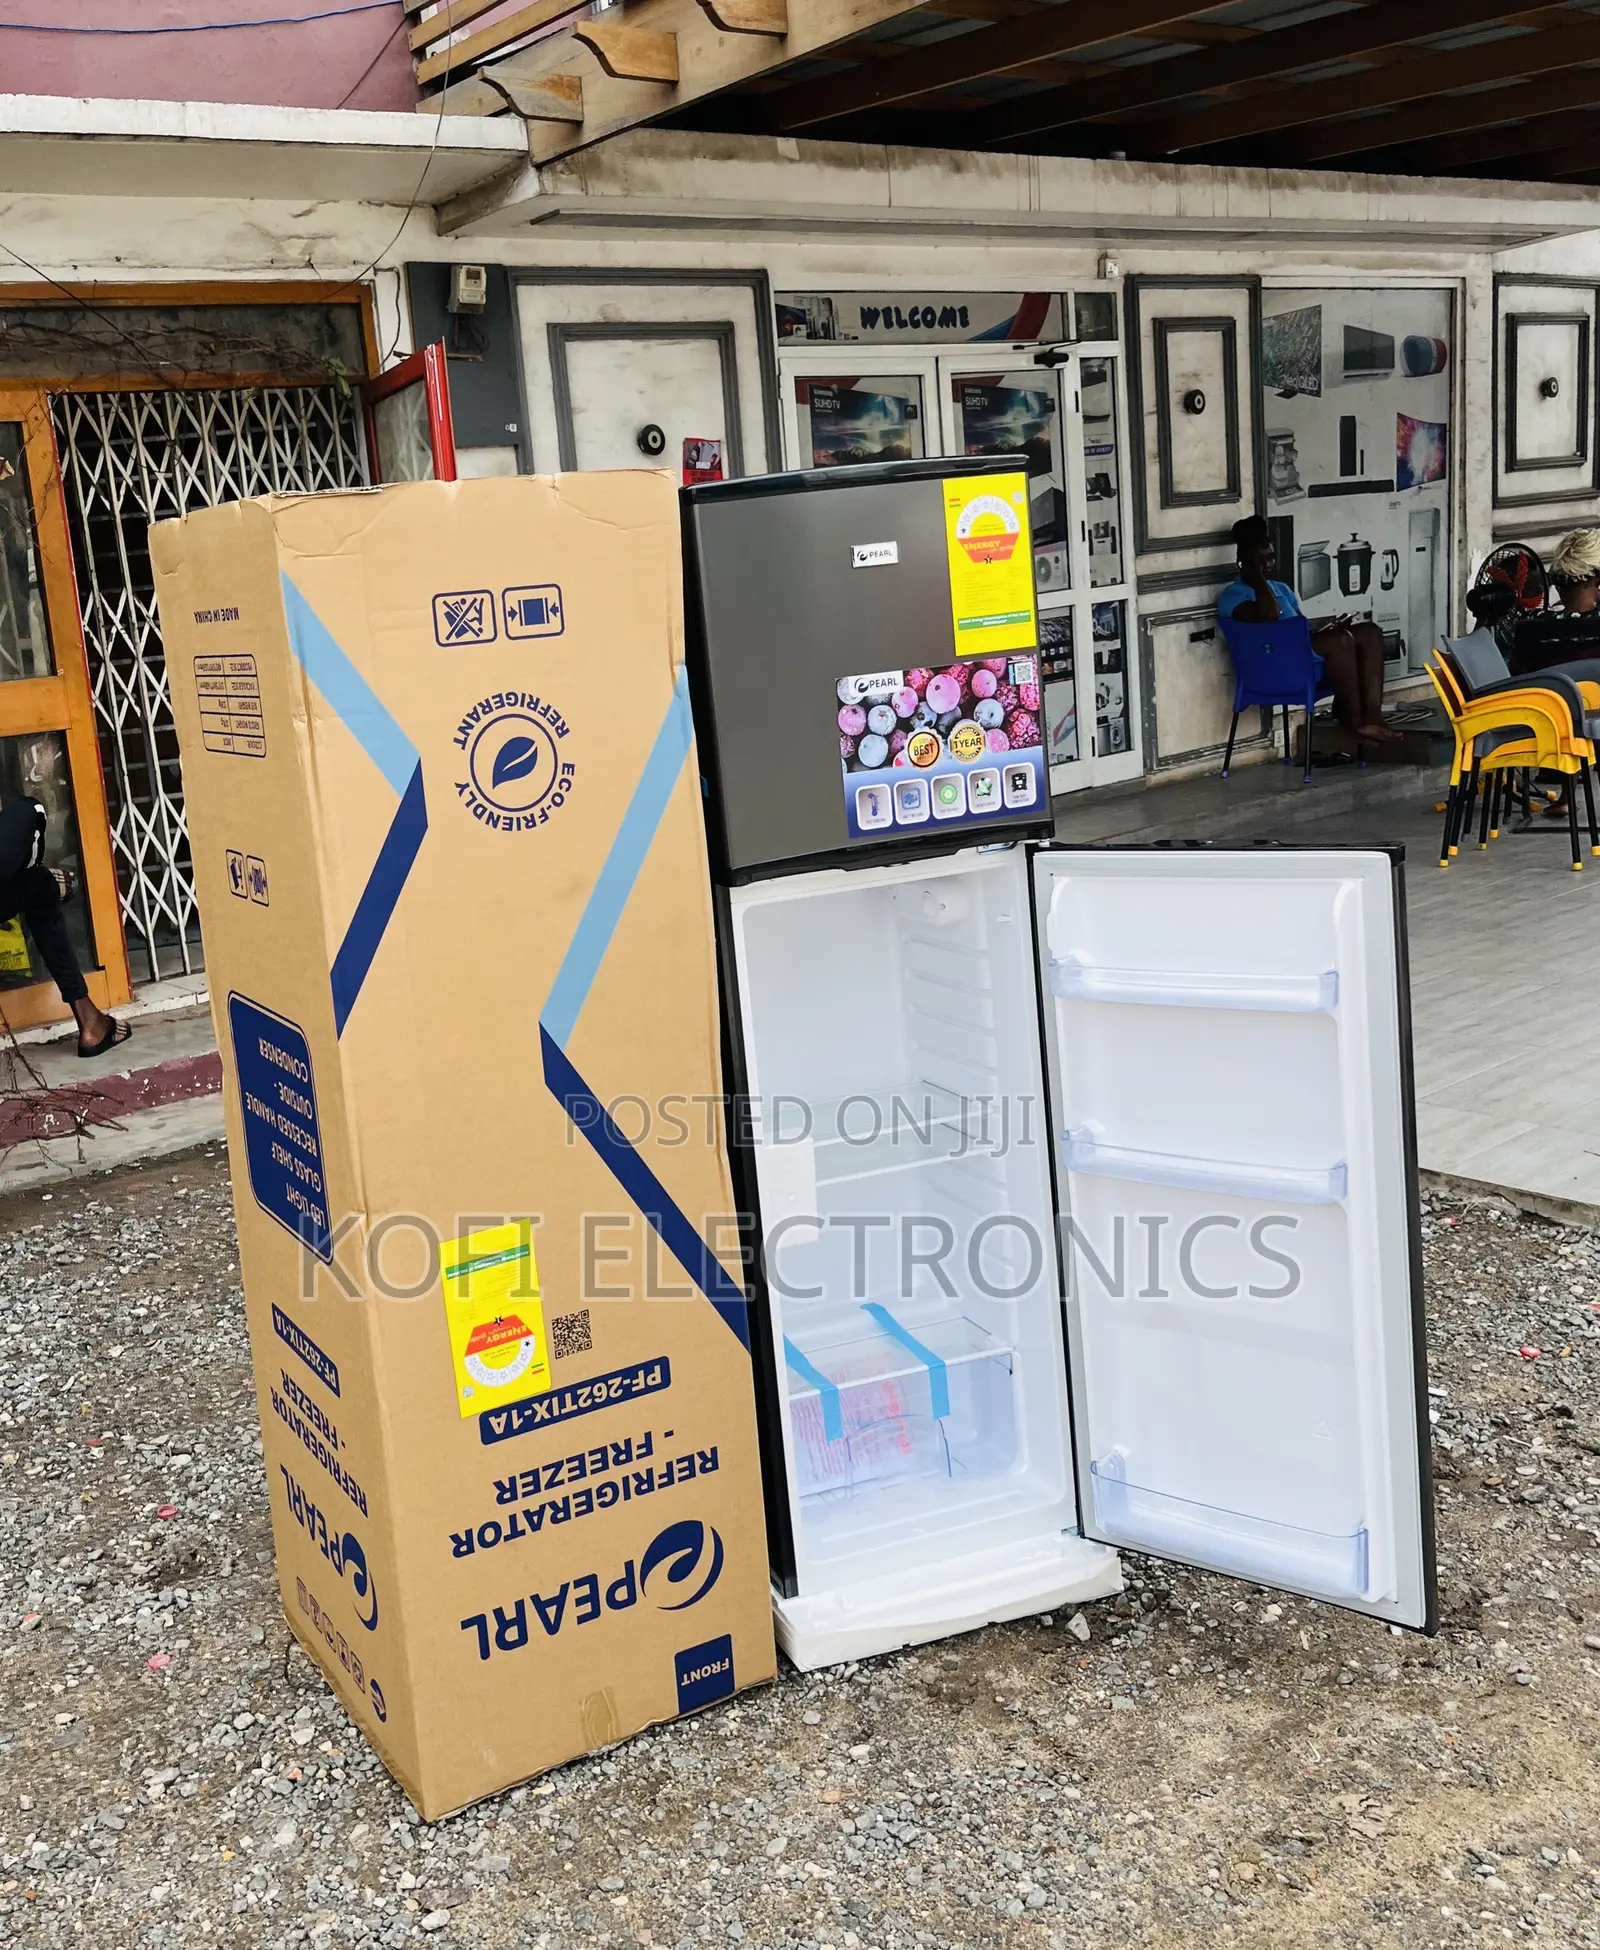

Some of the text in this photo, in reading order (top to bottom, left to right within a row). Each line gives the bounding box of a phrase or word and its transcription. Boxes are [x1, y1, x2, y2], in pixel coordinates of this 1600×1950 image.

[860, 305, 970, 330] WELCOME
[869, 549, 893, 558] PEARL
[194, 607, 239, 624] MADE IN CHINA
[869, 677, 898, 689] PEARL
[453, 691, 570, 750] REFRIGERANT
[960, 737, 982, 749] YEAR
[913, 743, 935, 756] BEST
[454, 762, 576, 832] ECO-FRIENDLY
[258, 1036, 309, 1084] CONDENSER
[245, 1092, 318, 1158] RECESSED HANDLE
[279, 1081, 313, 1120] OUTSIDE
[271, 1141, 321, 1193] GLASS SHELF
[286, 1182, 326, 1230] LED LIGHT
[274, 1309, 337, 1389] PF-262TIX-1A
[486, 1325, 528, 1345] ENERGY
[280, 1368, 339, 1451] FREEZER
[489, 1364, 662, 1436] PF-262TIX-1A
[270, 1386, 368, 1519] REFRIGERATOR
[493, 1431, 654, 1505] FREEZER
[280, 1463, 343, 1577] PEARL
[449, 1446, 719, 1558] REFRIGERATOR
[460, 1559, 638, 1660] PEARL
[680, 1657, 730, 1686] FRONT
